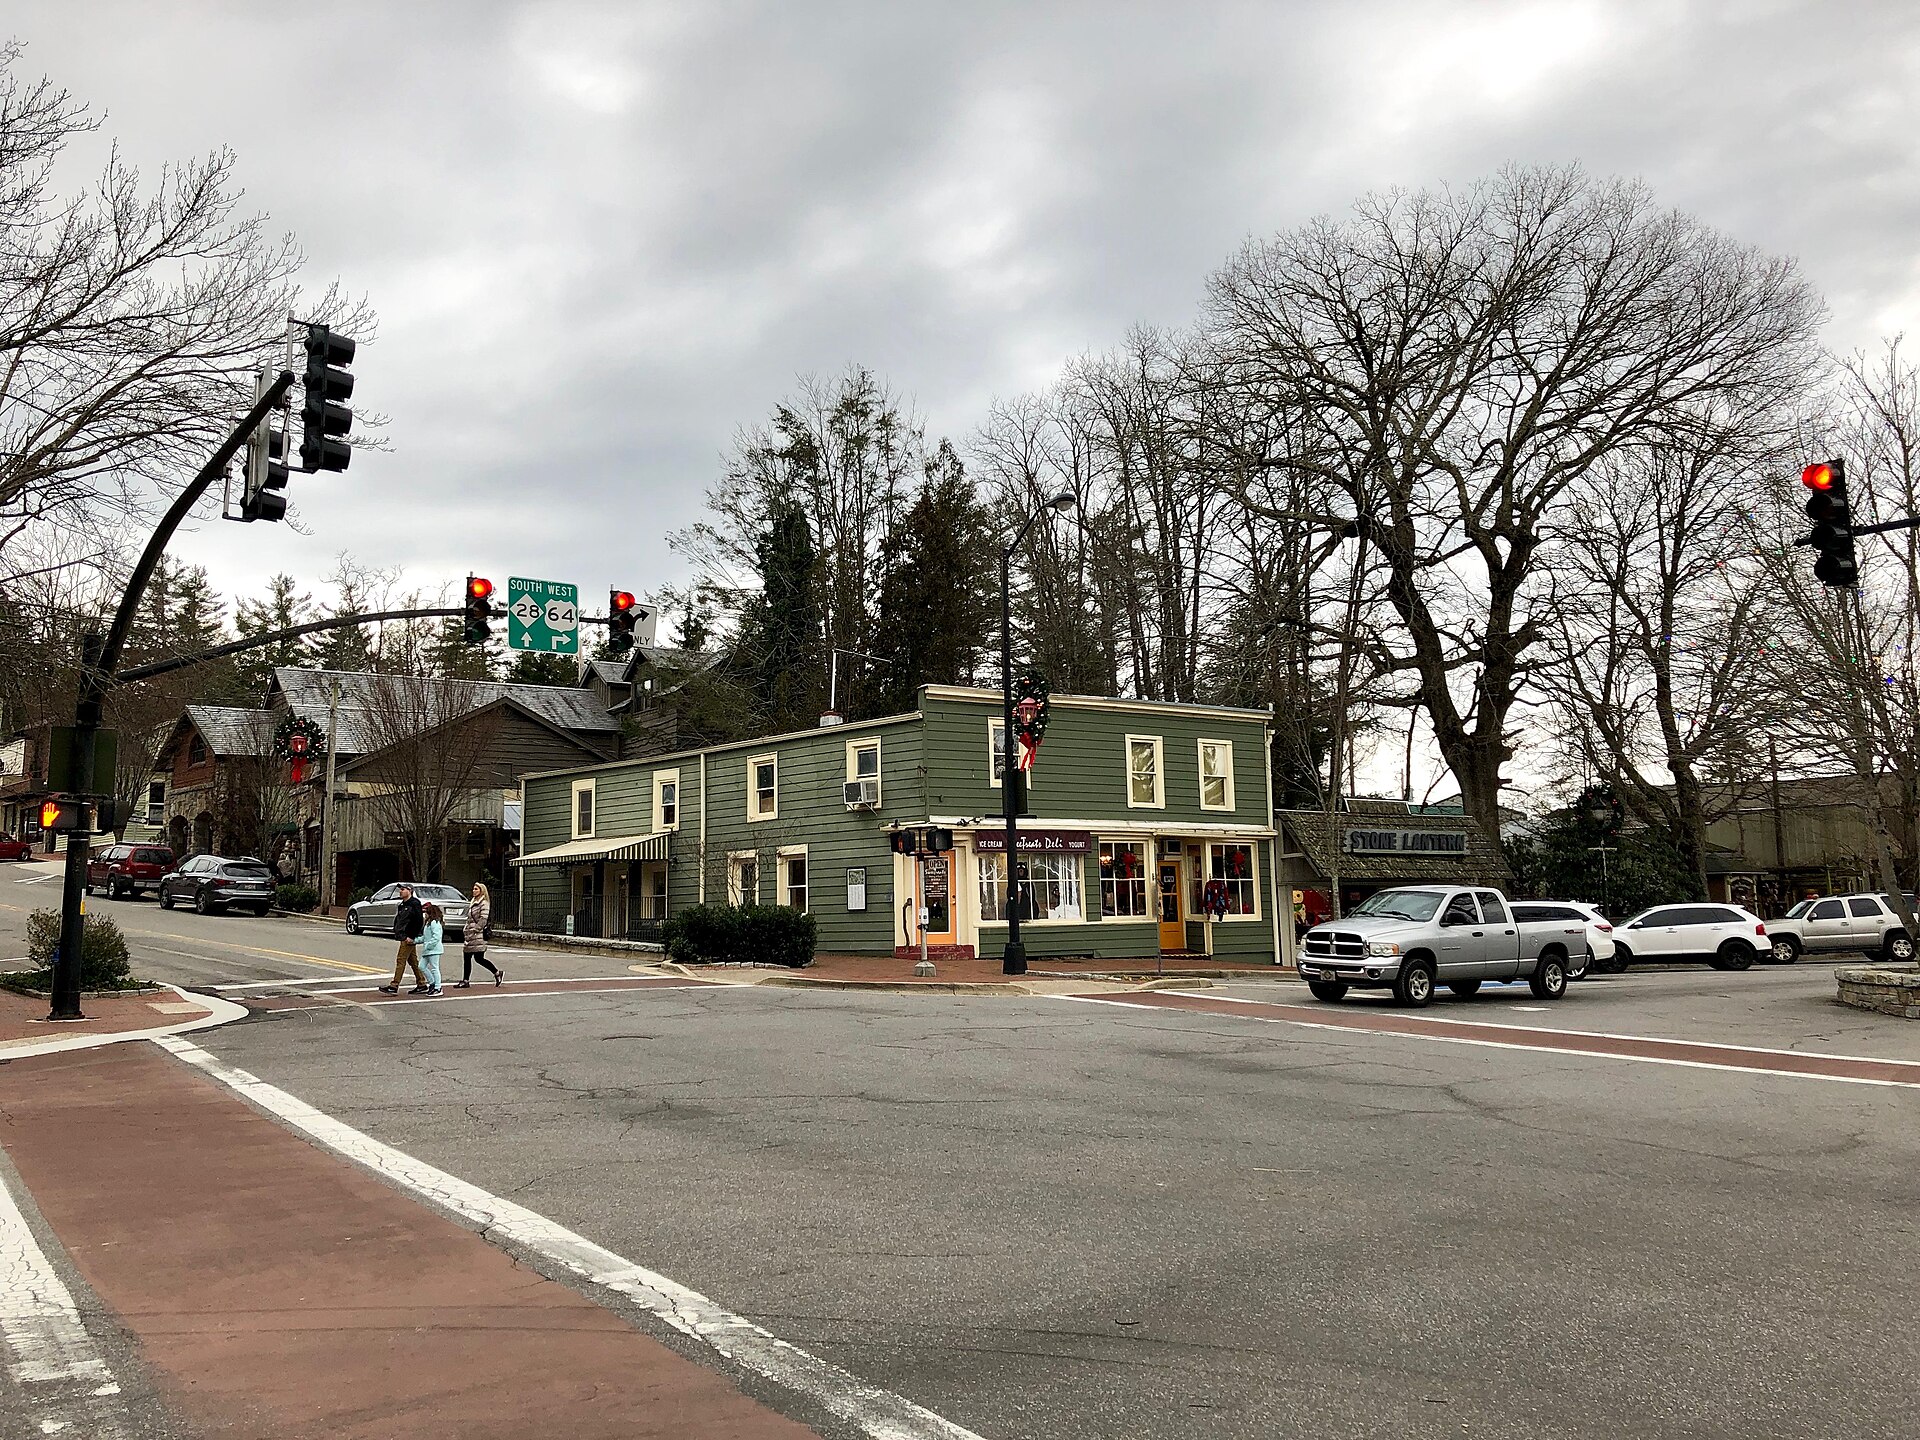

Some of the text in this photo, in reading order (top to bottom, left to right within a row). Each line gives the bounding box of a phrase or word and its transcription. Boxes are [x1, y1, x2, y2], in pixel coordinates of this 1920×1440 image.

[510, 579, 573, 597] SOUTH WEST
[516, 603, 575, 623] 28 64
[633, 635, 651, 645] NLY
[979, 840, 987, 848] ICE
[987, 840, 1003, 848] CREAM
[1044, 836, 1064, 849] Deli
[1350, 830, 1465, 851] STONE LANTERN
[929, 859, 945, 868] OPEN
